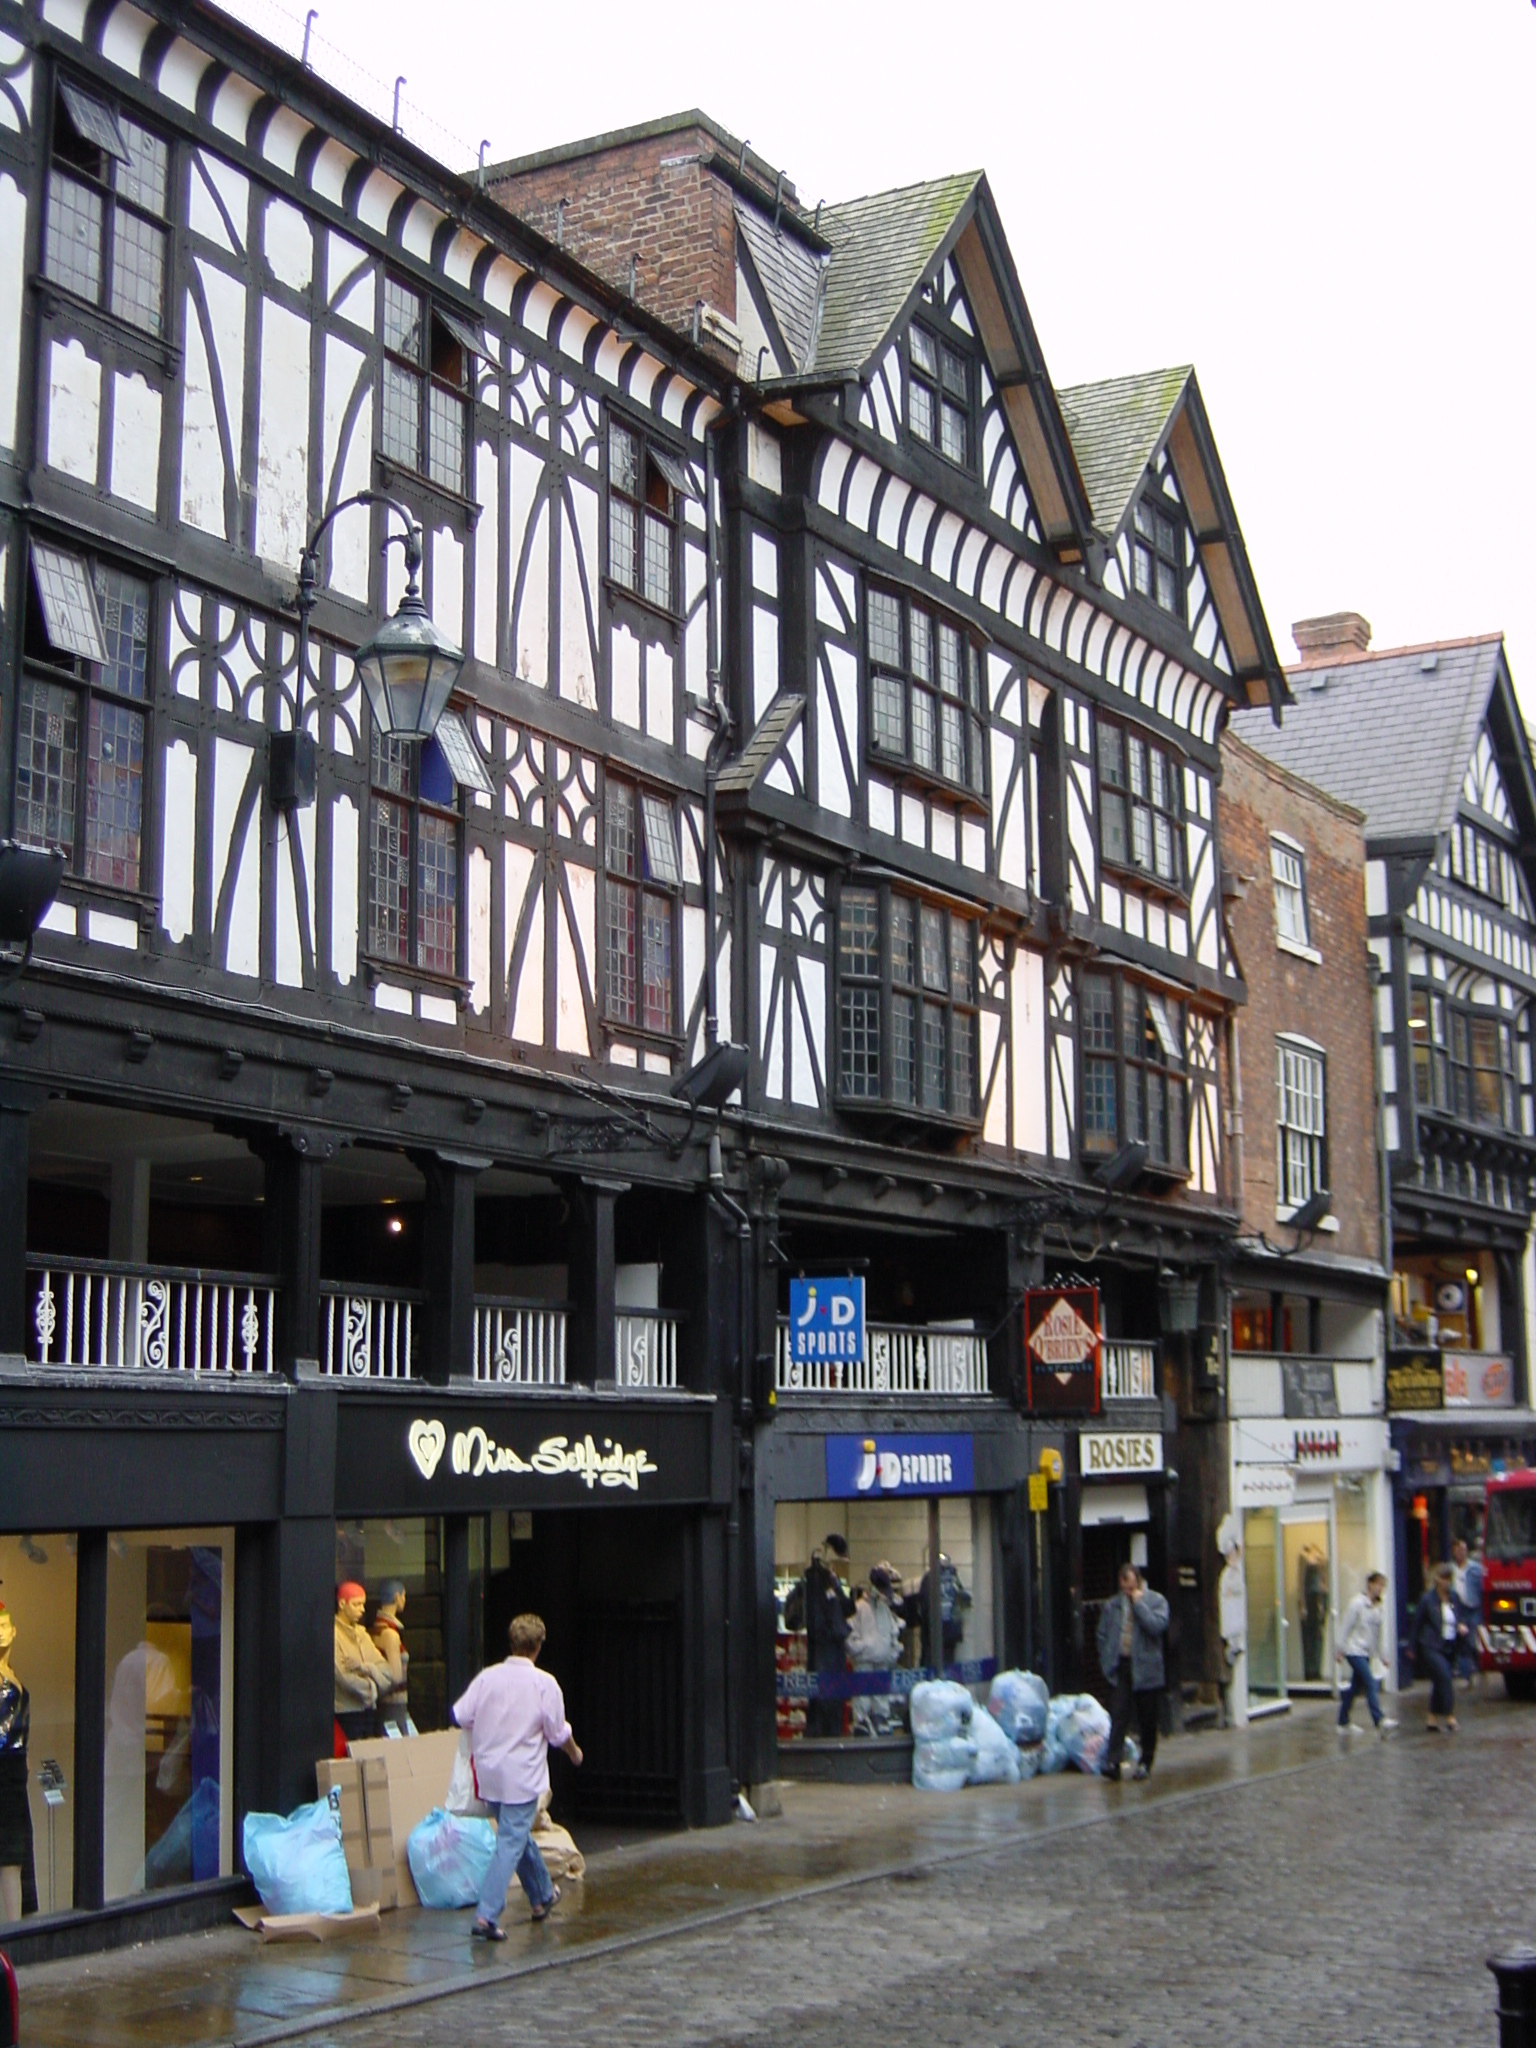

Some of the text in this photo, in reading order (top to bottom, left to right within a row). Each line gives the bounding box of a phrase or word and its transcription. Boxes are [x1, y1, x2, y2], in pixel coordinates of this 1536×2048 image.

[797, 1331, 856, 1355] SPORTS
[452, 1426, 658, 1491] Miss Selfridge
[1088, 1438, 1154, 1468] ROSIES
[902, 1454, 953, 1484] SPORTS
[892, 1668, 927, 1687] FREE
